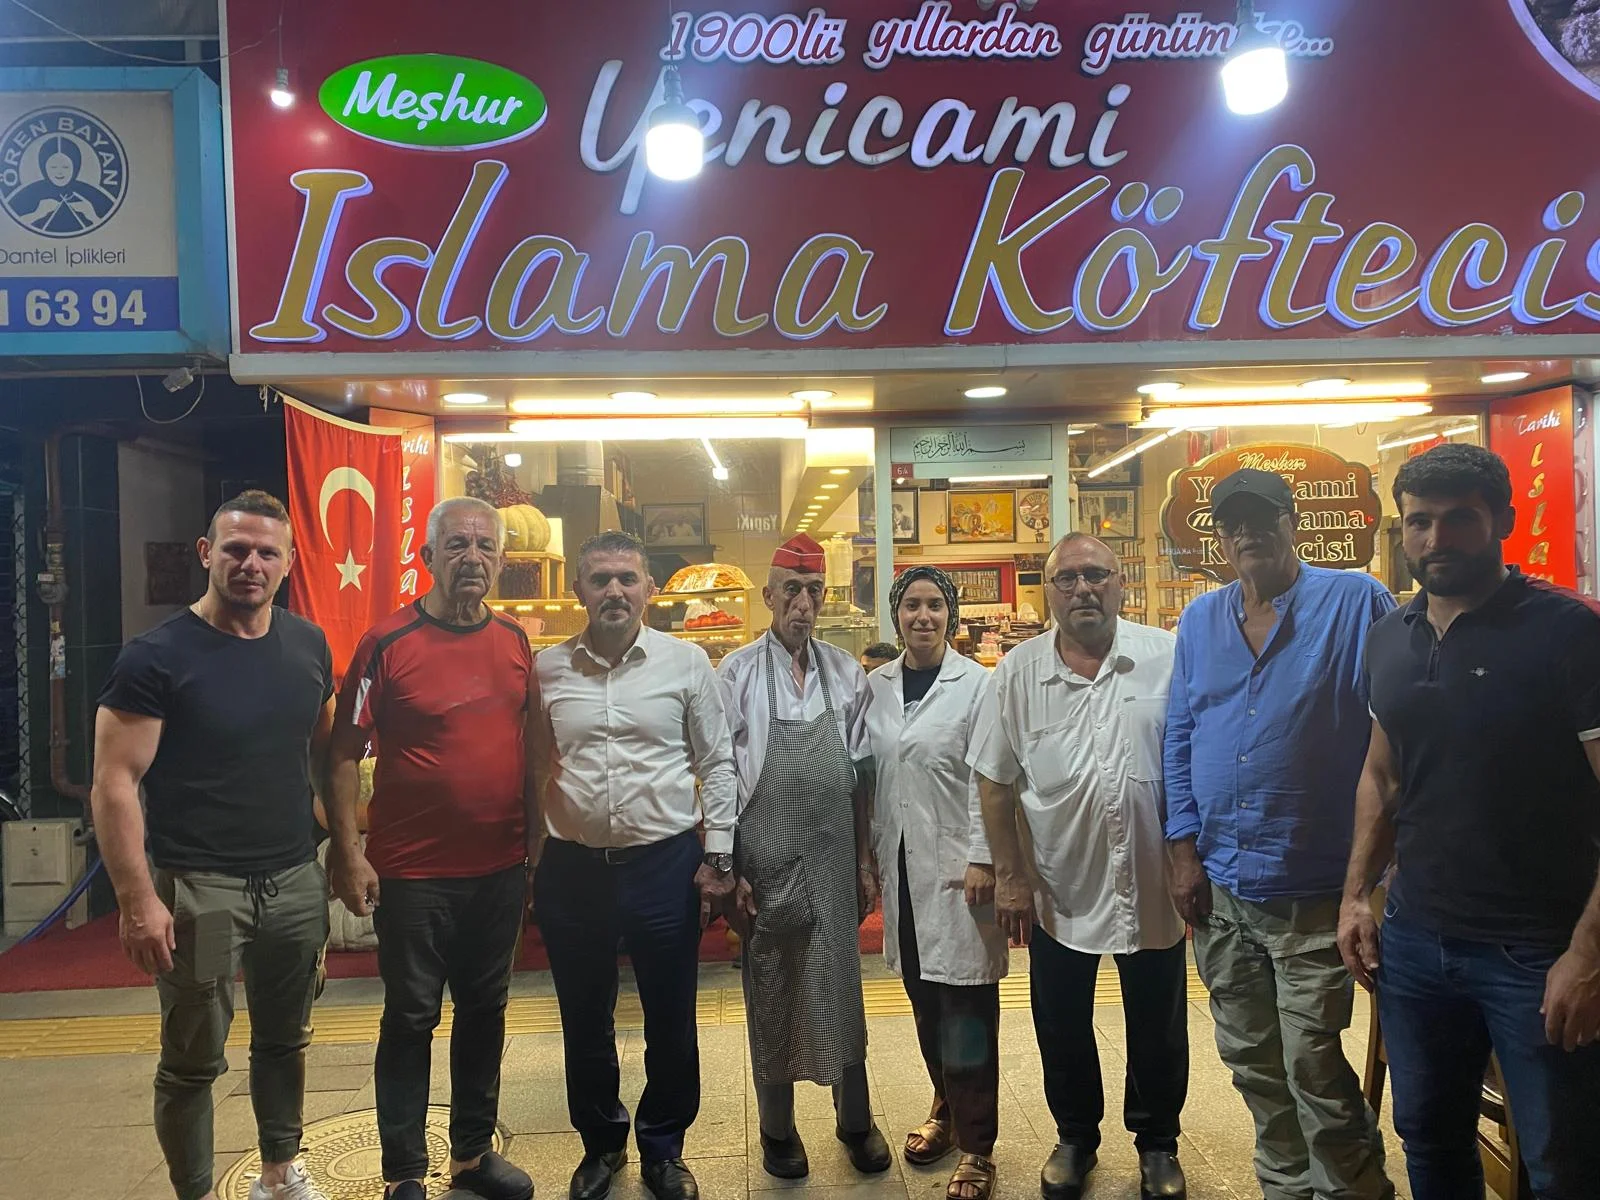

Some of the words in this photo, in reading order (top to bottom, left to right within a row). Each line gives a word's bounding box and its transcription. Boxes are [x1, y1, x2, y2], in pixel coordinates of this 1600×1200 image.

[661, 9, 846, 63] 1900lü
[864, 3, 1061, 67] yıllardan
[342, 71, 523, 130] Meşhur
[0, 120, 48, 187] ÖREN
[58, 116, 118, 186] BAYAN
[65, 245, 126, 268] İplikleri
[249, 160, 888, 343] Islama
[25, 289, 80, 327] 63
[91, 289, 147, 326] 94
